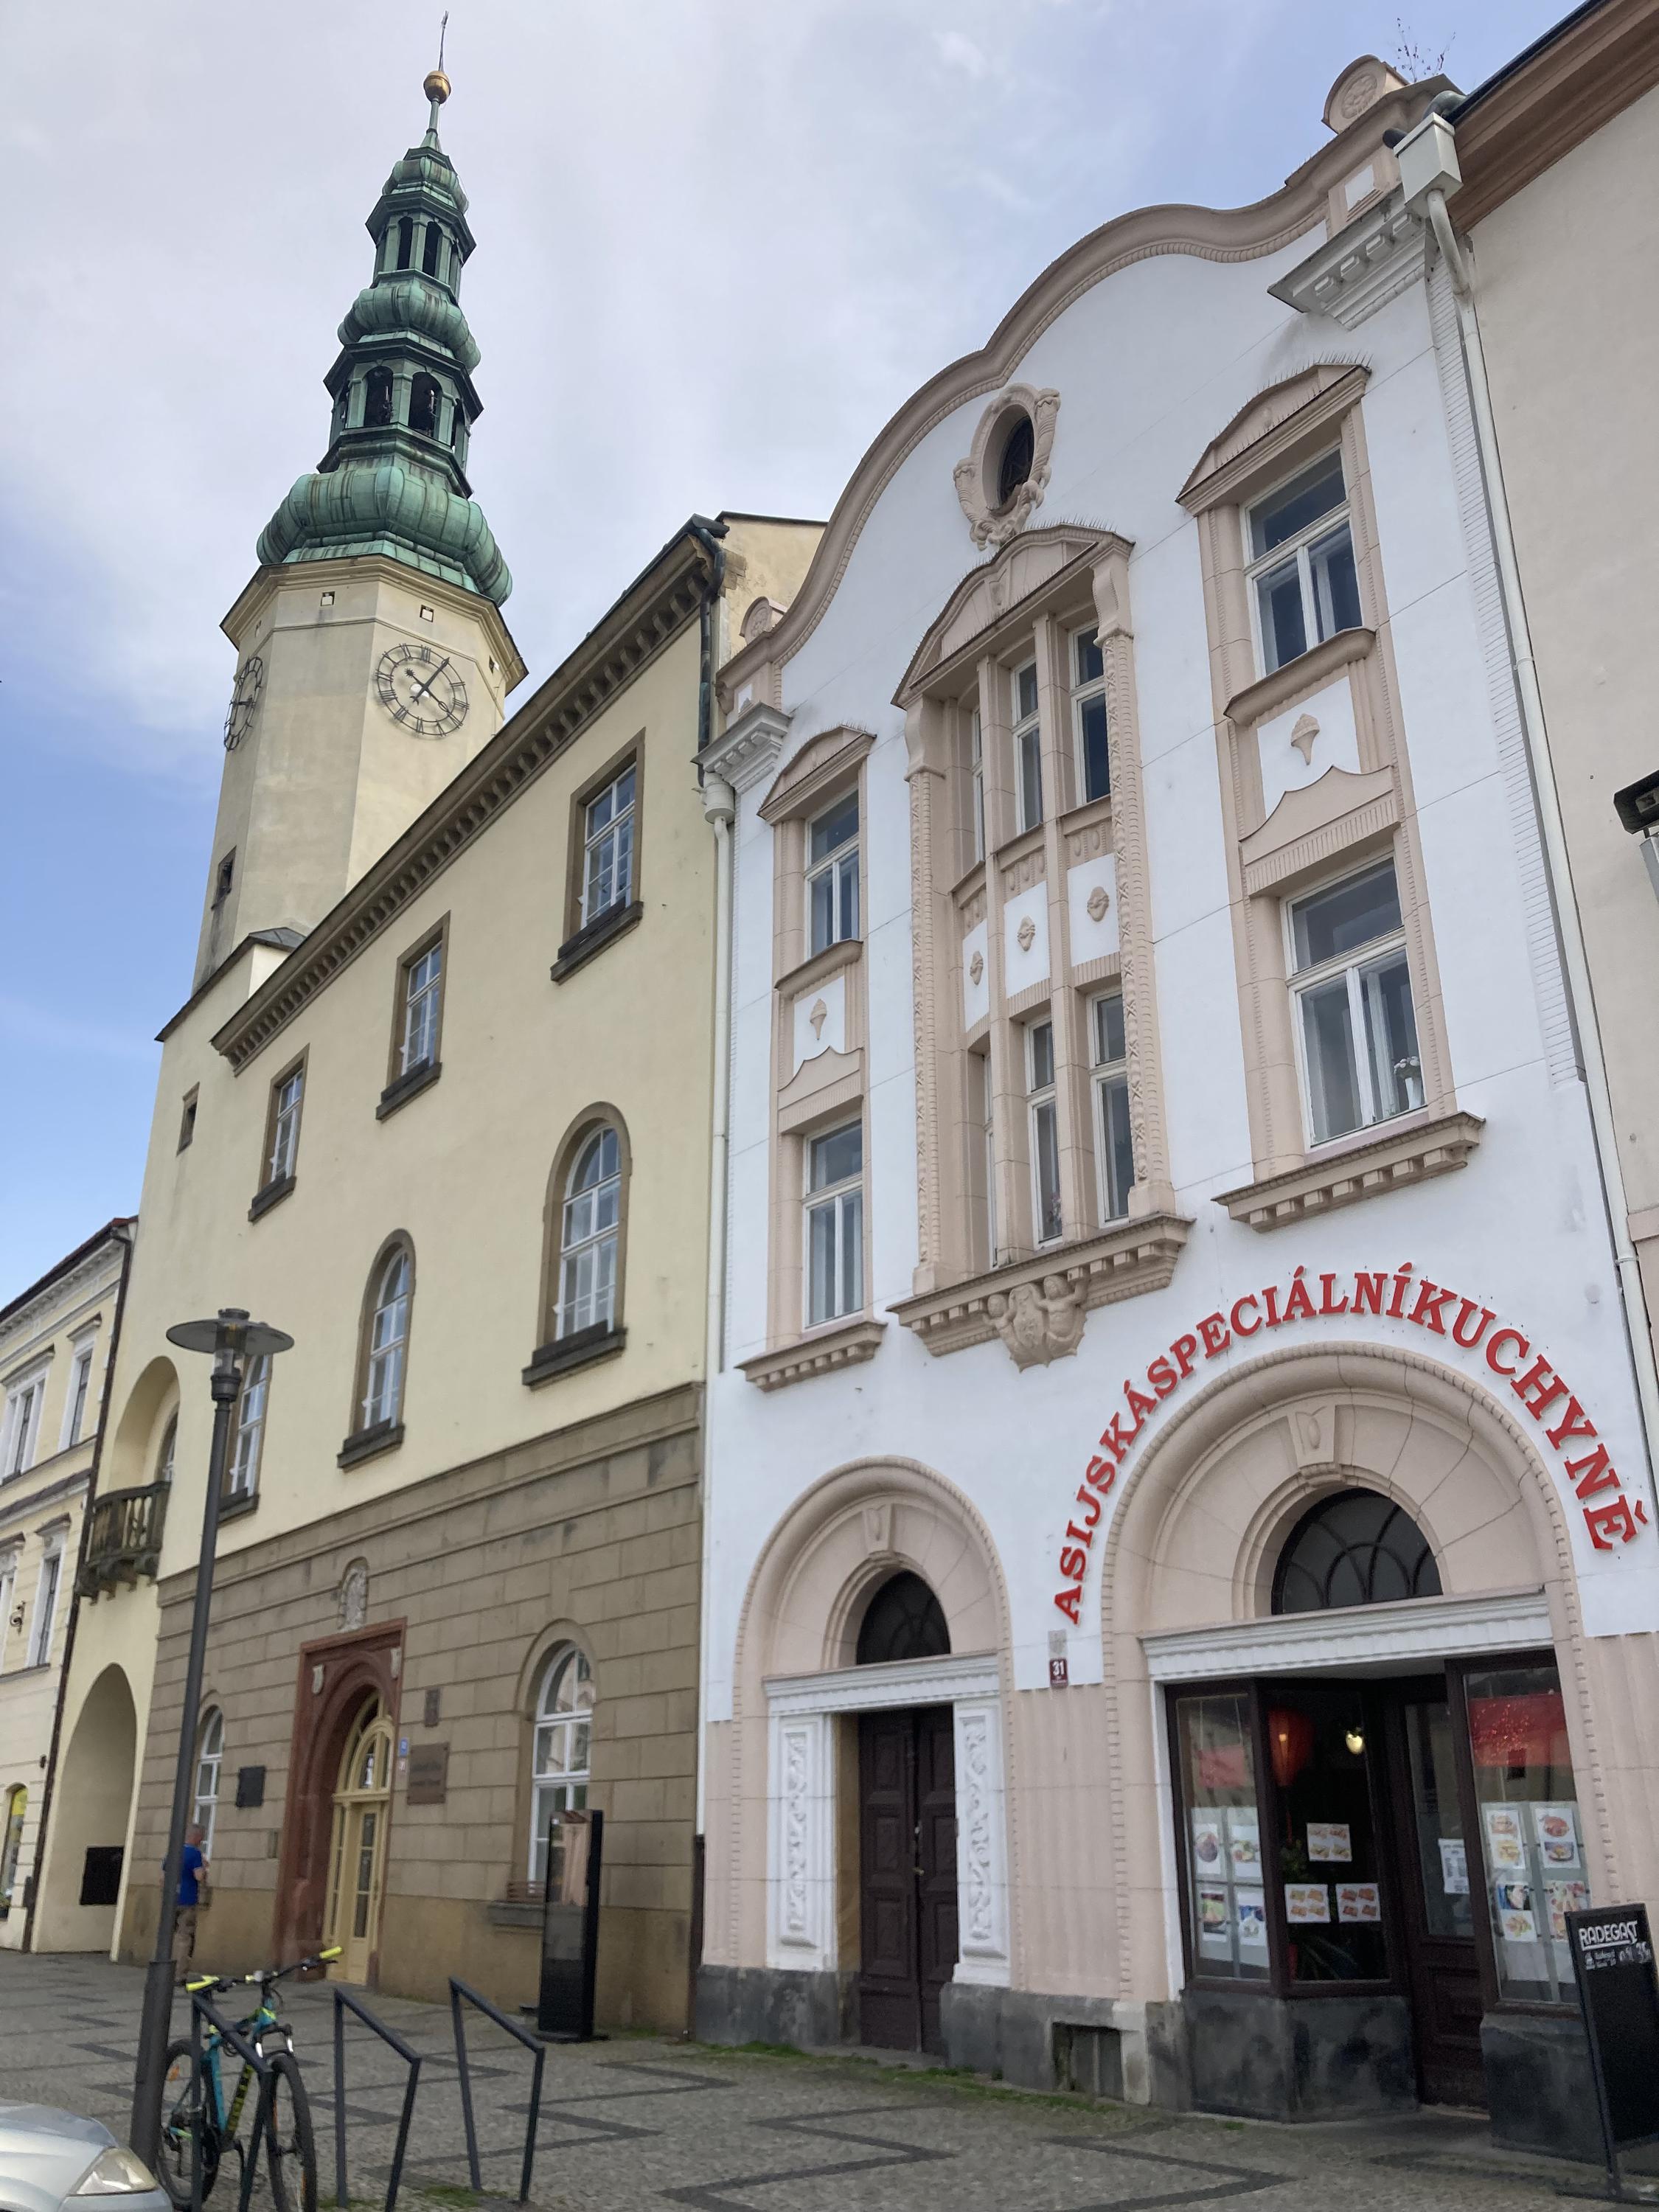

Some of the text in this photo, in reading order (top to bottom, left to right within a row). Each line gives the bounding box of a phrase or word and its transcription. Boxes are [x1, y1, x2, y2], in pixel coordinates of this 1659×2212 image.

[1055, 1262, 1649, 1625] ASIJSKÁ SPECIÁLNÍ KUCHYNĚ
[1052, 1660, 1065, 1676] 31
[1579, 1920, 1638, 1951] RADEGAST
